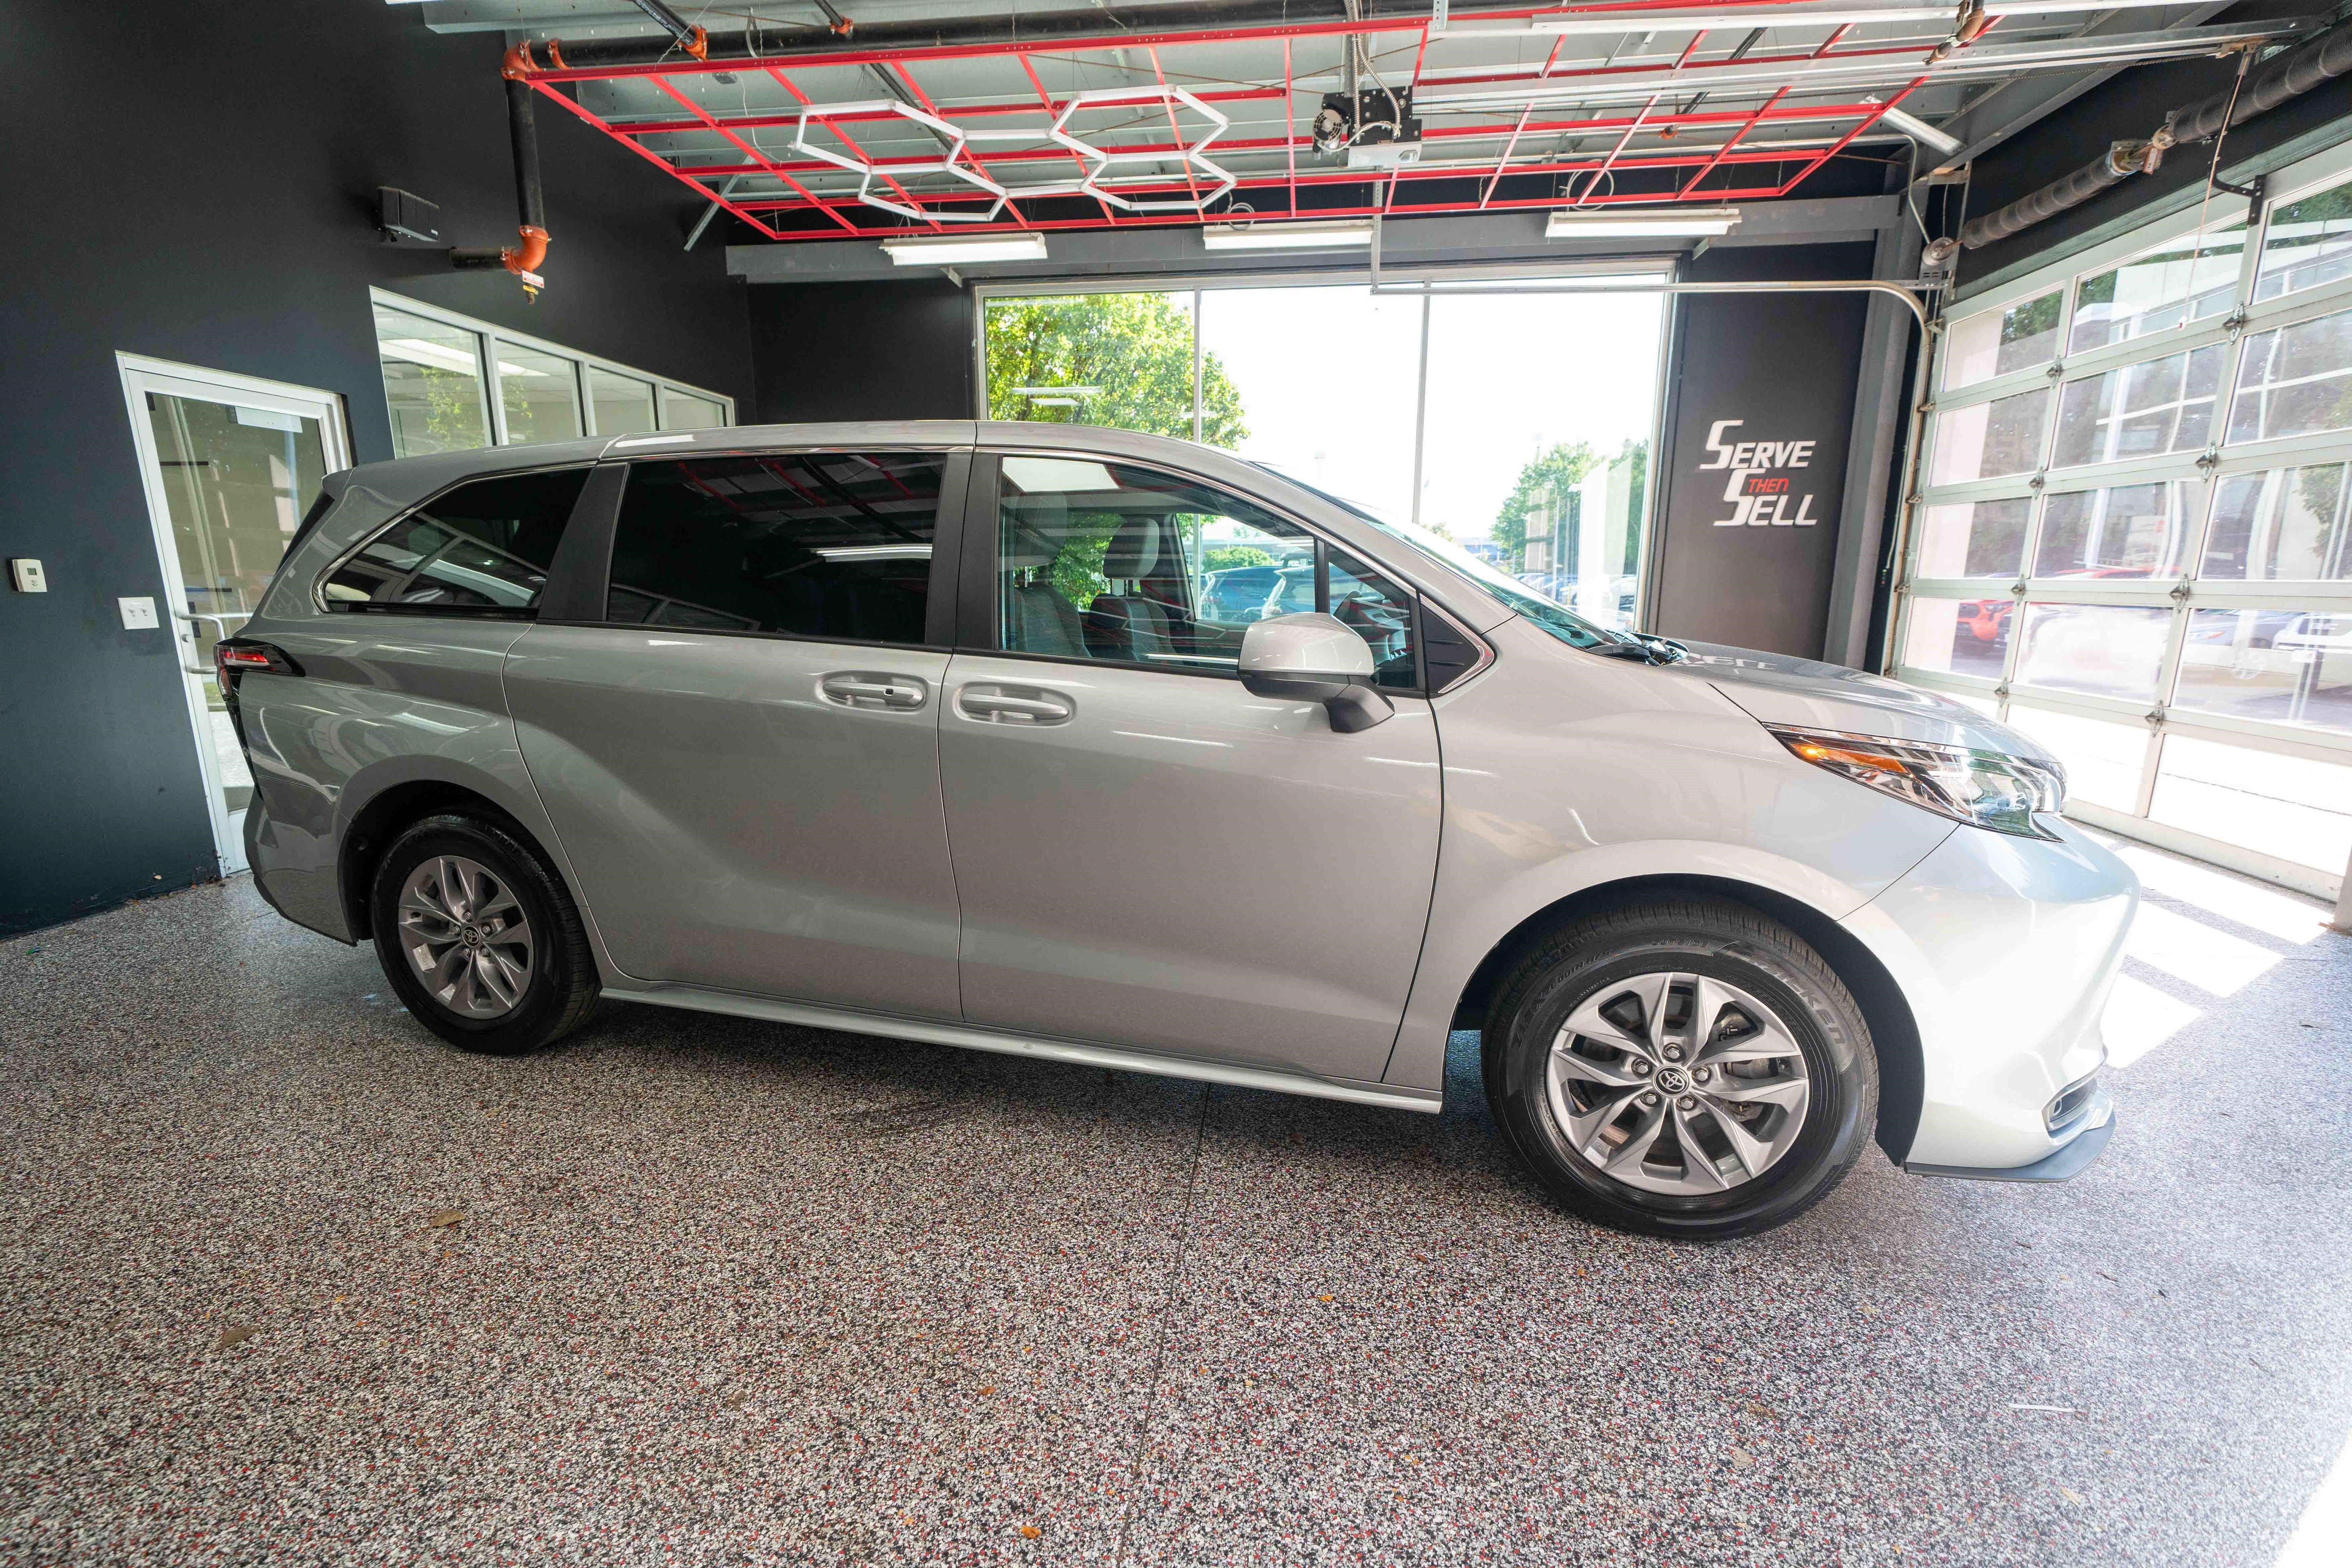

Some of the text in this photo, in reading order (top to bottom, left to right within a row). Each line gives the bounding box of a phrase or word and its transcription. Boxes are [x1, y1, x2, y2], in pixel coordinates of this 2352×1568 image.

[1699, 420, 1817, 469] SERVE
[1713, 468, 1817, 526] SELL
[1748, 478, 1789, 492] THEN
[1651, 938, 1709, 948] OUTSIDE
